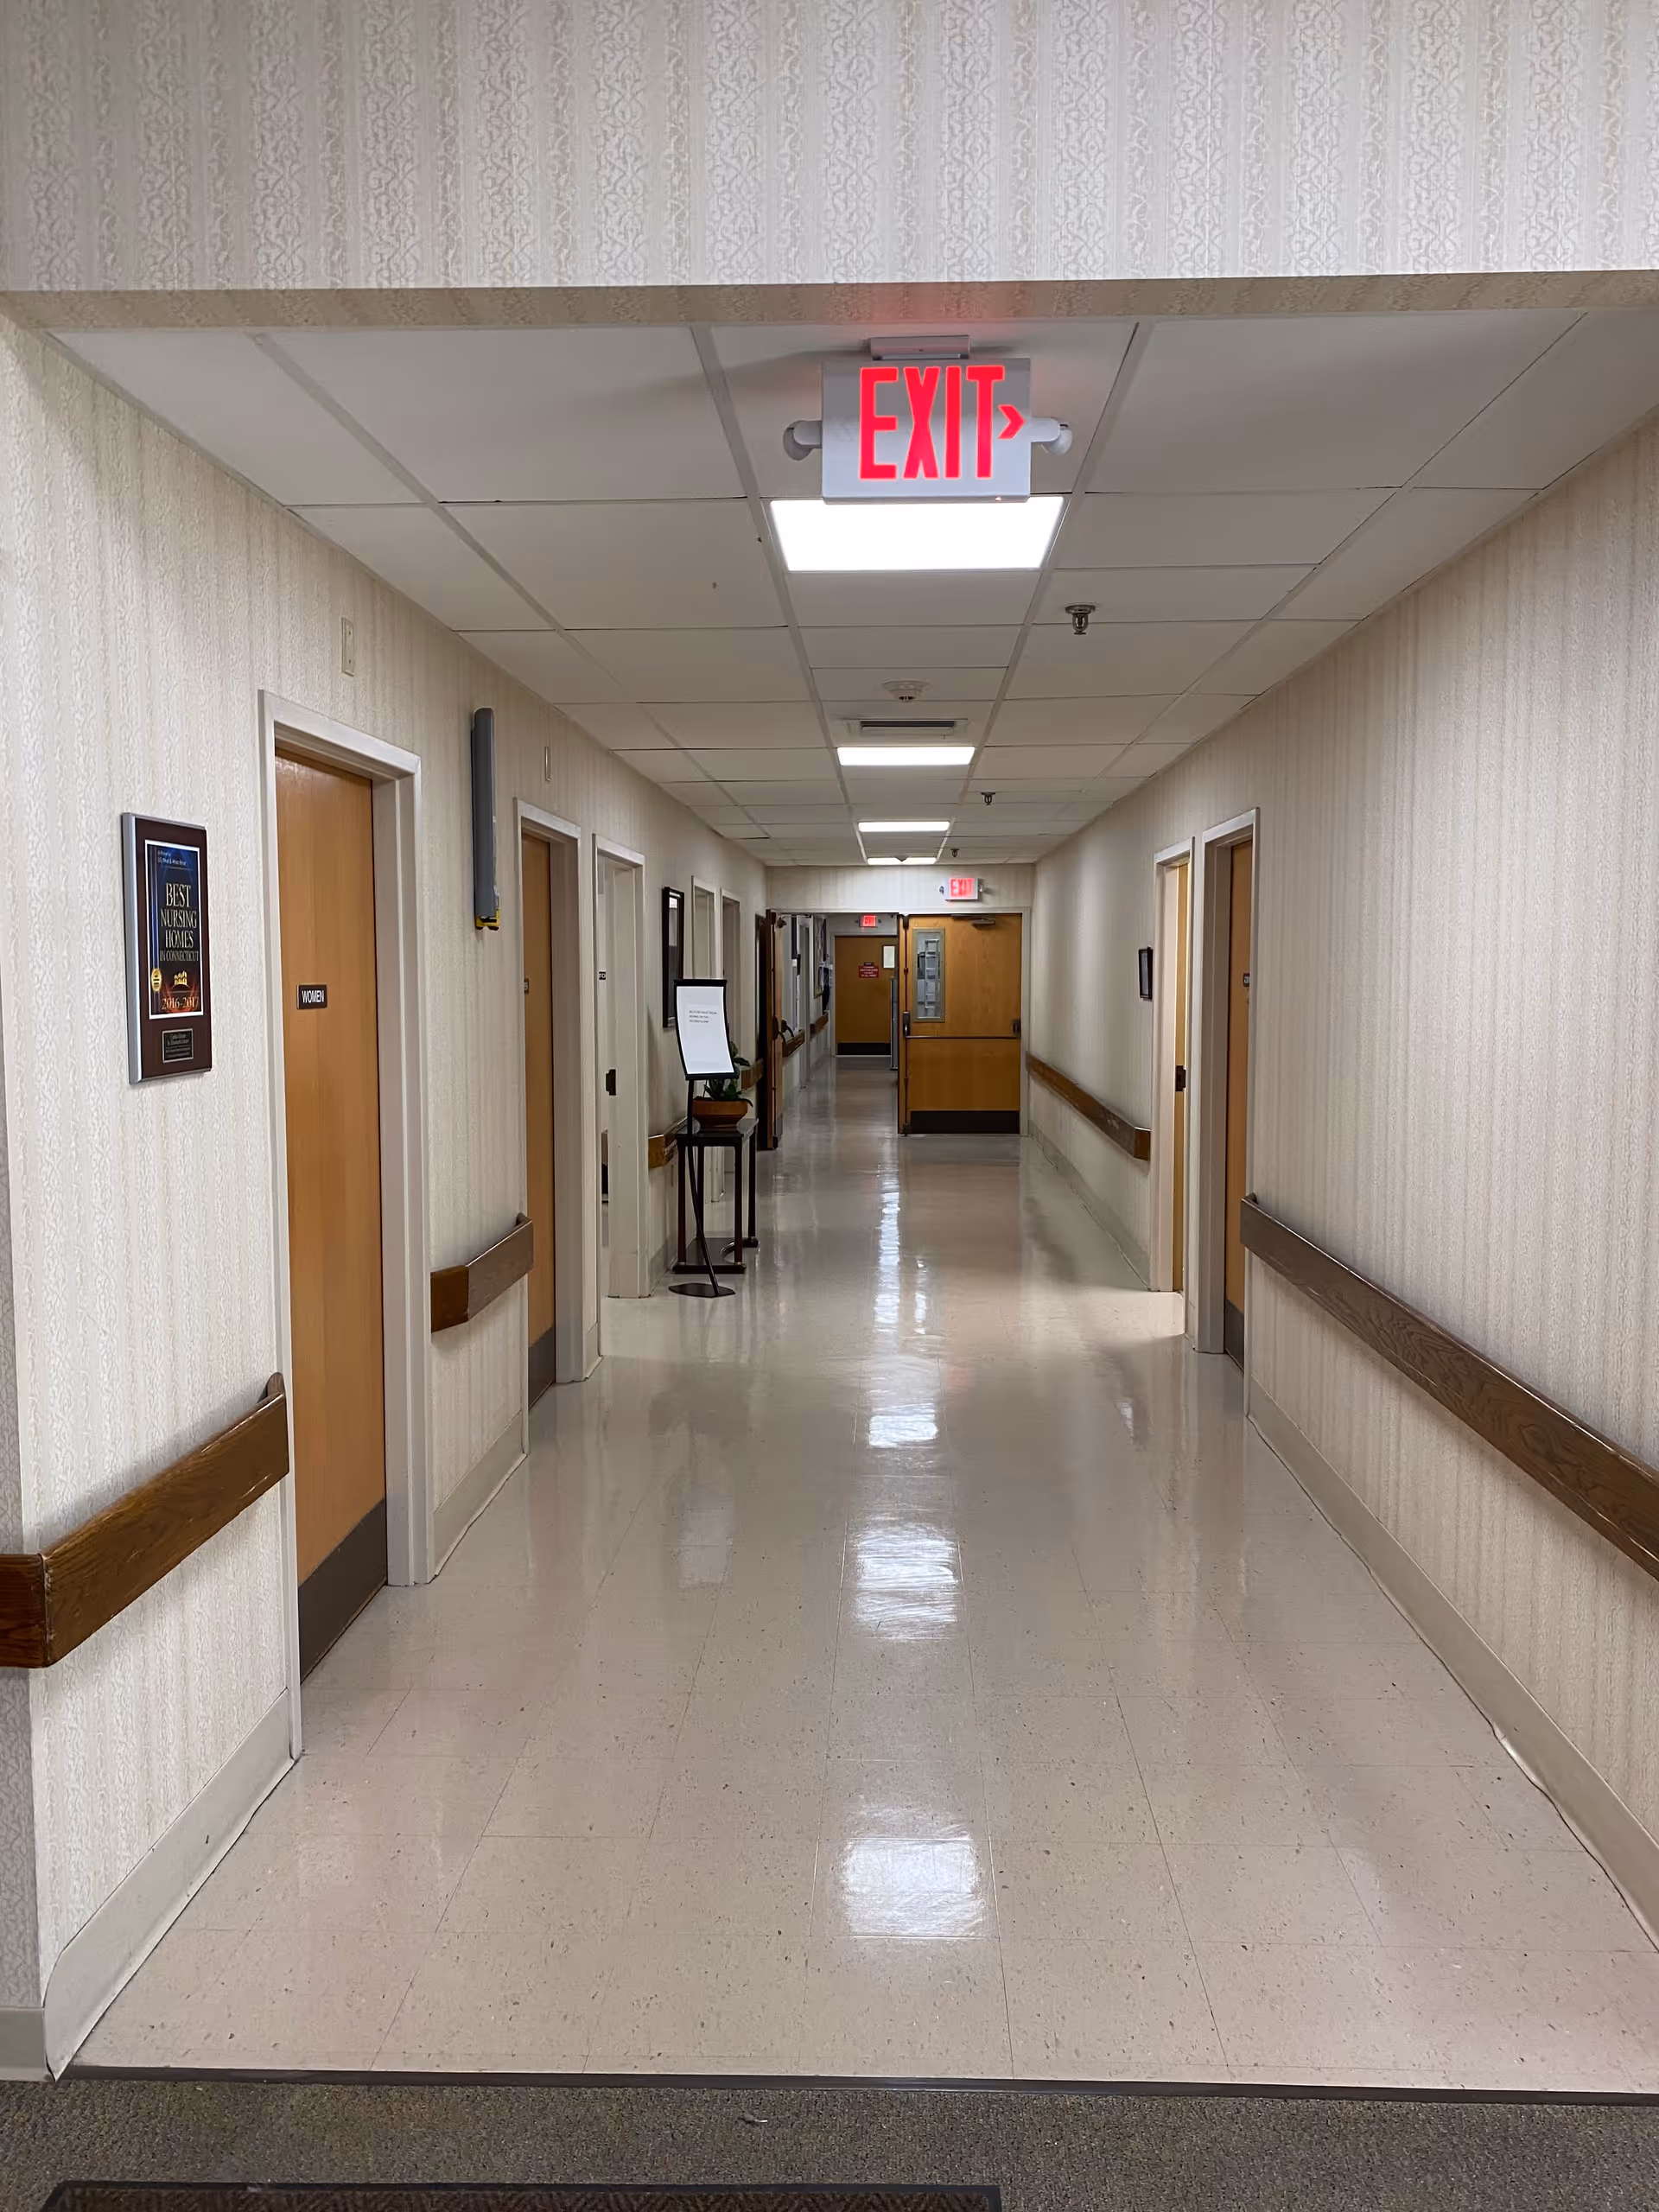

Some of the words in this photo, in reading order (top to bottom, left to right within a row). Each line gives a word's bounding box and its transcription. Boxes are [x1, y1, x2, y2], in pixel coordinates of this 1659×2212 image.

[859, 365, 1005, 480] EXIT
[165, 882, 192, 908] BEST
[950, 878, 974, 897] EXIT
[160, 908, 197, 929] NURSING
[165, 929, 194, 949] HOMES
[160, 950, 166, 962] IN
[166, 950, 200, 962] CONNECTICUT
[161, 996, 200, 1010] 2016-2017
[302, 989, 325, 1003] WOMEN
